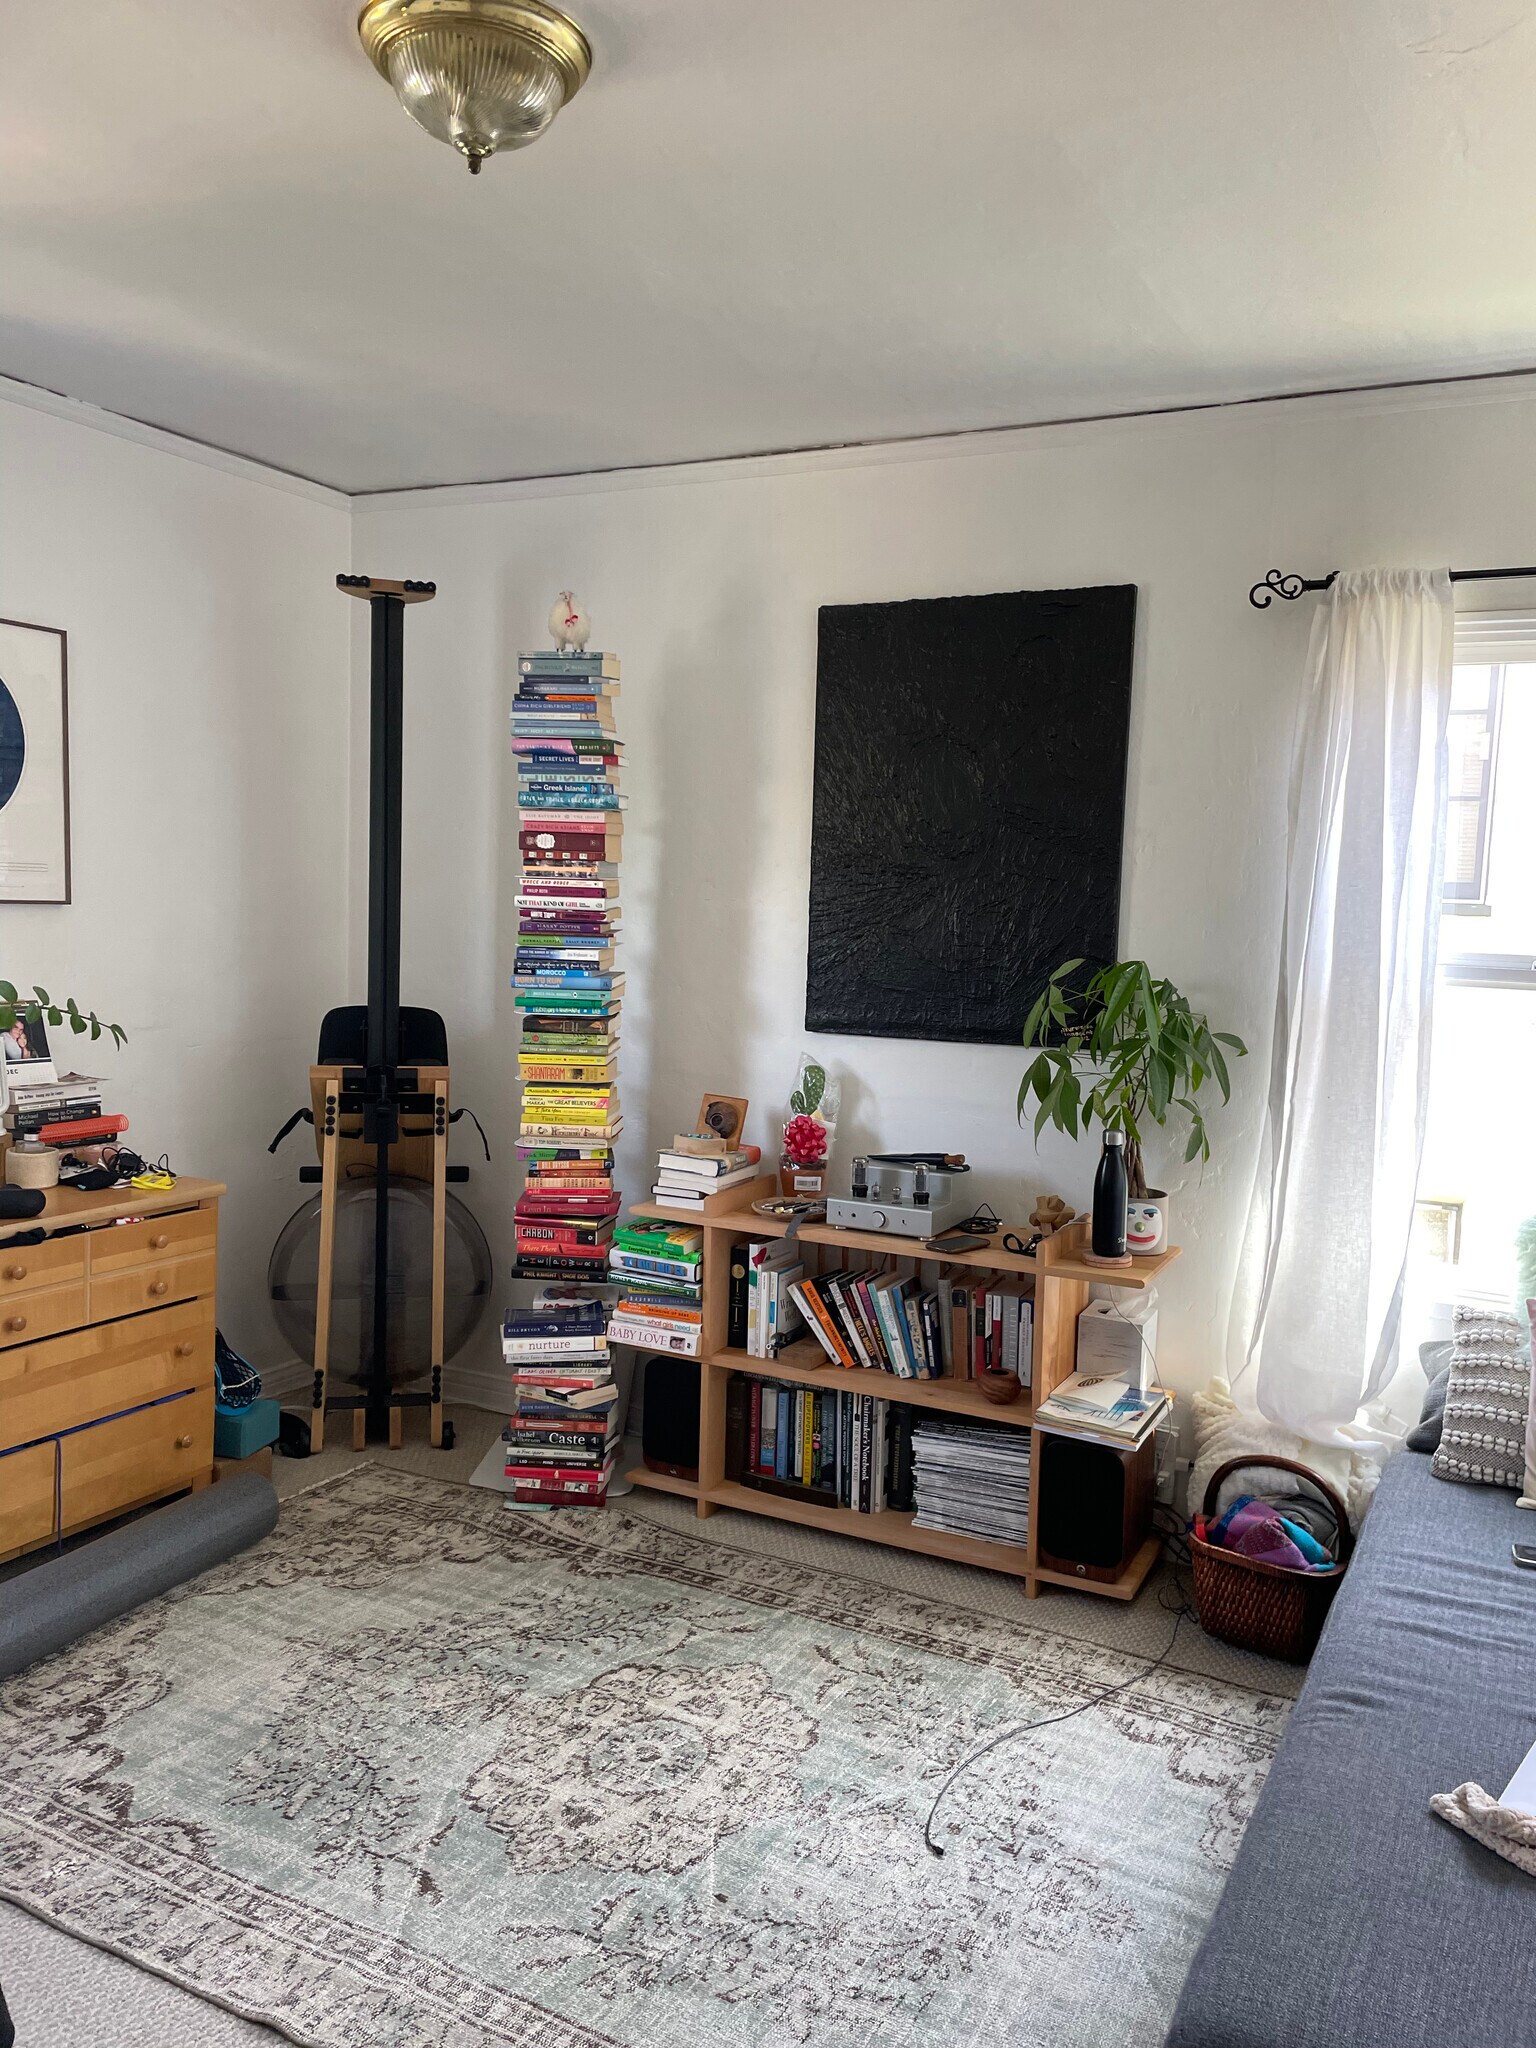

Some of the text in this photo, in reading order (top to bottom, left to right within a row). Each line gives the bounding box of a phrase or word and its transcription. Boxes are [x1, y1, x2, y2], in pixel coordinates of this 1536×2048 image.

[527, 1066, 565, 1080] SHANTARAM
[521, 1228, 553, 1238] CHABON
[628, 1246, 650, 1255] Everything
[647, 1318, 690, 1331] what girls need
[610, 1326, 668, 1346] BABY LOVE
[855, 1318, 875, 1357] HELL'S ANGELS
[529, 1340, 571, 1350] nurture
[549, 1432, 585, 1445] Caste
[862, 1396, 872, 1481] Chairmaker's Notebook
